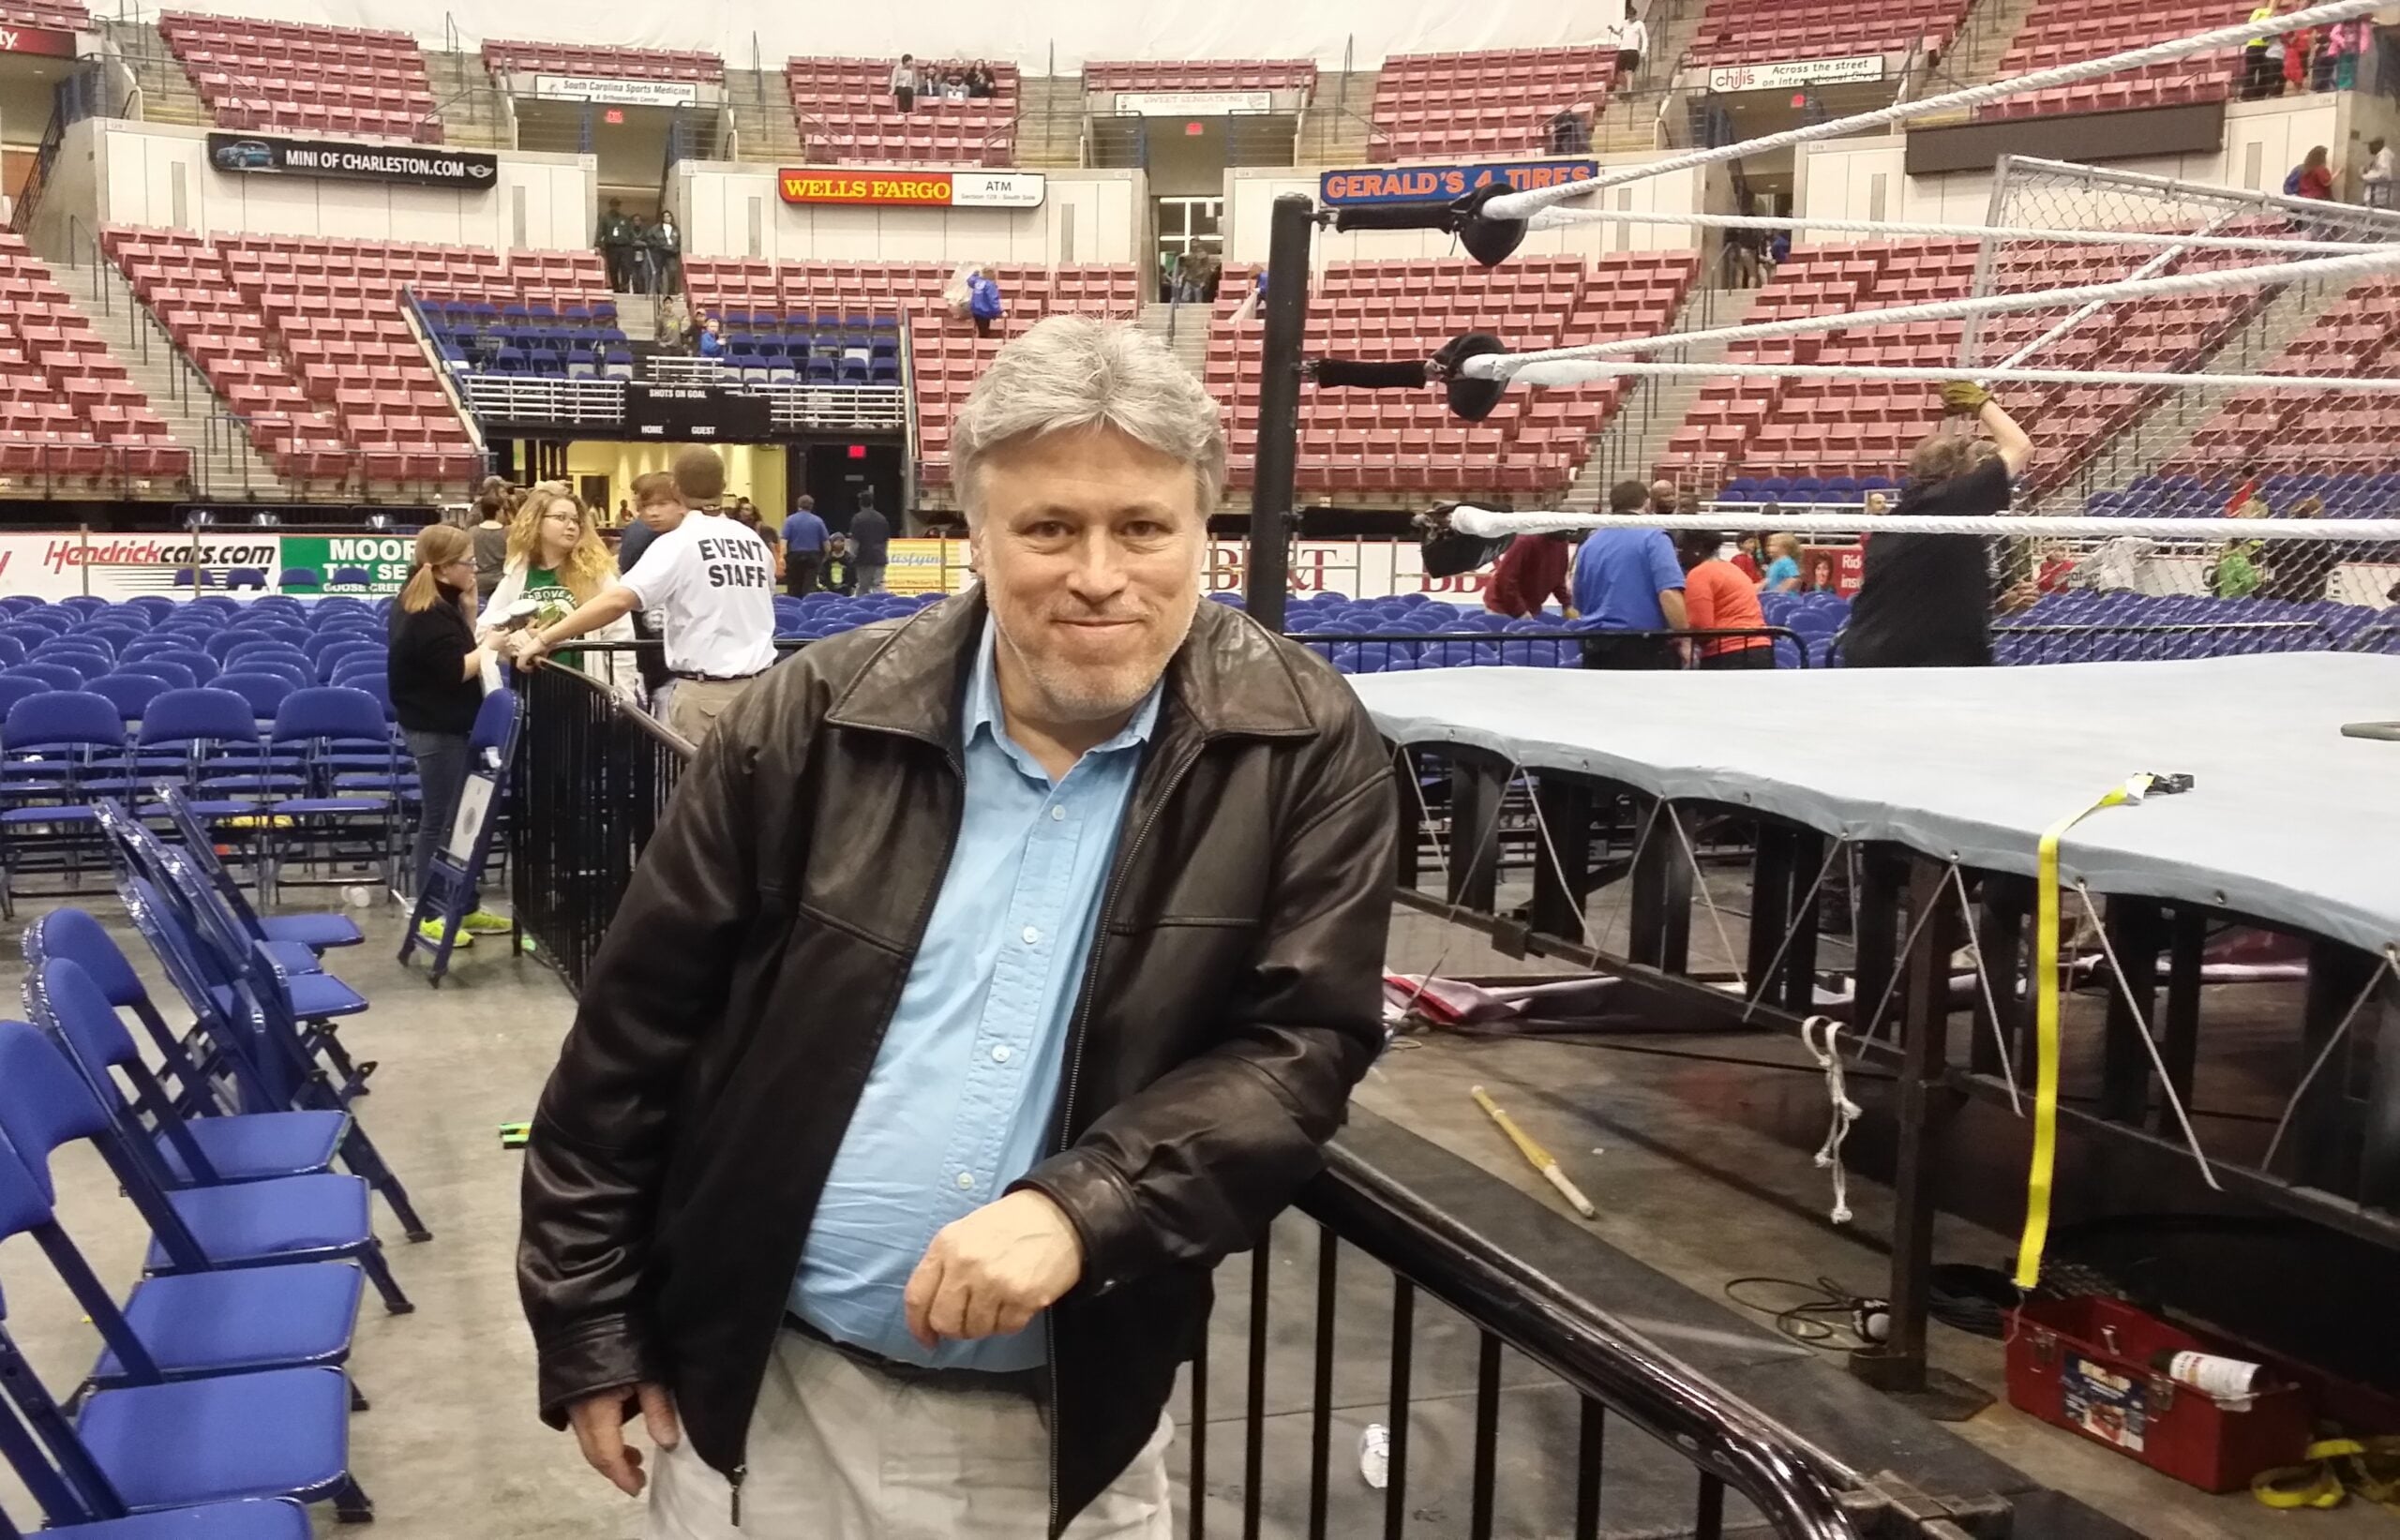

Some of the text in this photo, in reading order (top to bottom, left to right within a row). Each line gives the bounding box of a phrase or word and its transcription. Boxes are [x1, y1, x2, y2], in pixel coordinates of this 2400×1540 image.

[1772, 60, 1868, 75] Across the street
[1762, 79, 1775, 87] on
[1779, 72, 1847, 85] Intertional
[563, 80, 691, 96] South Carolina Sports Medicine
[286, 150, 464, 177] MINI OF CHARLESTON.COM
[785, 179, 952, 200] WELLS FARGO
[985, 181, 1012, 191] ATM
[1327, 172, 1465, 199] GERALD'S
[1505, 166, 1591, 191] TIRES
[649, 389, 707, 398] SHOTS ON GOAL
[641, 425, 716, 435] HOME GUEST
[43, 540, 276, 575] Hendrickcars.com
[698, 538, 763, 562] EVENT
[708, 564, 767, 588] STAFF
[322, 582, 367, 592] GOOSE
